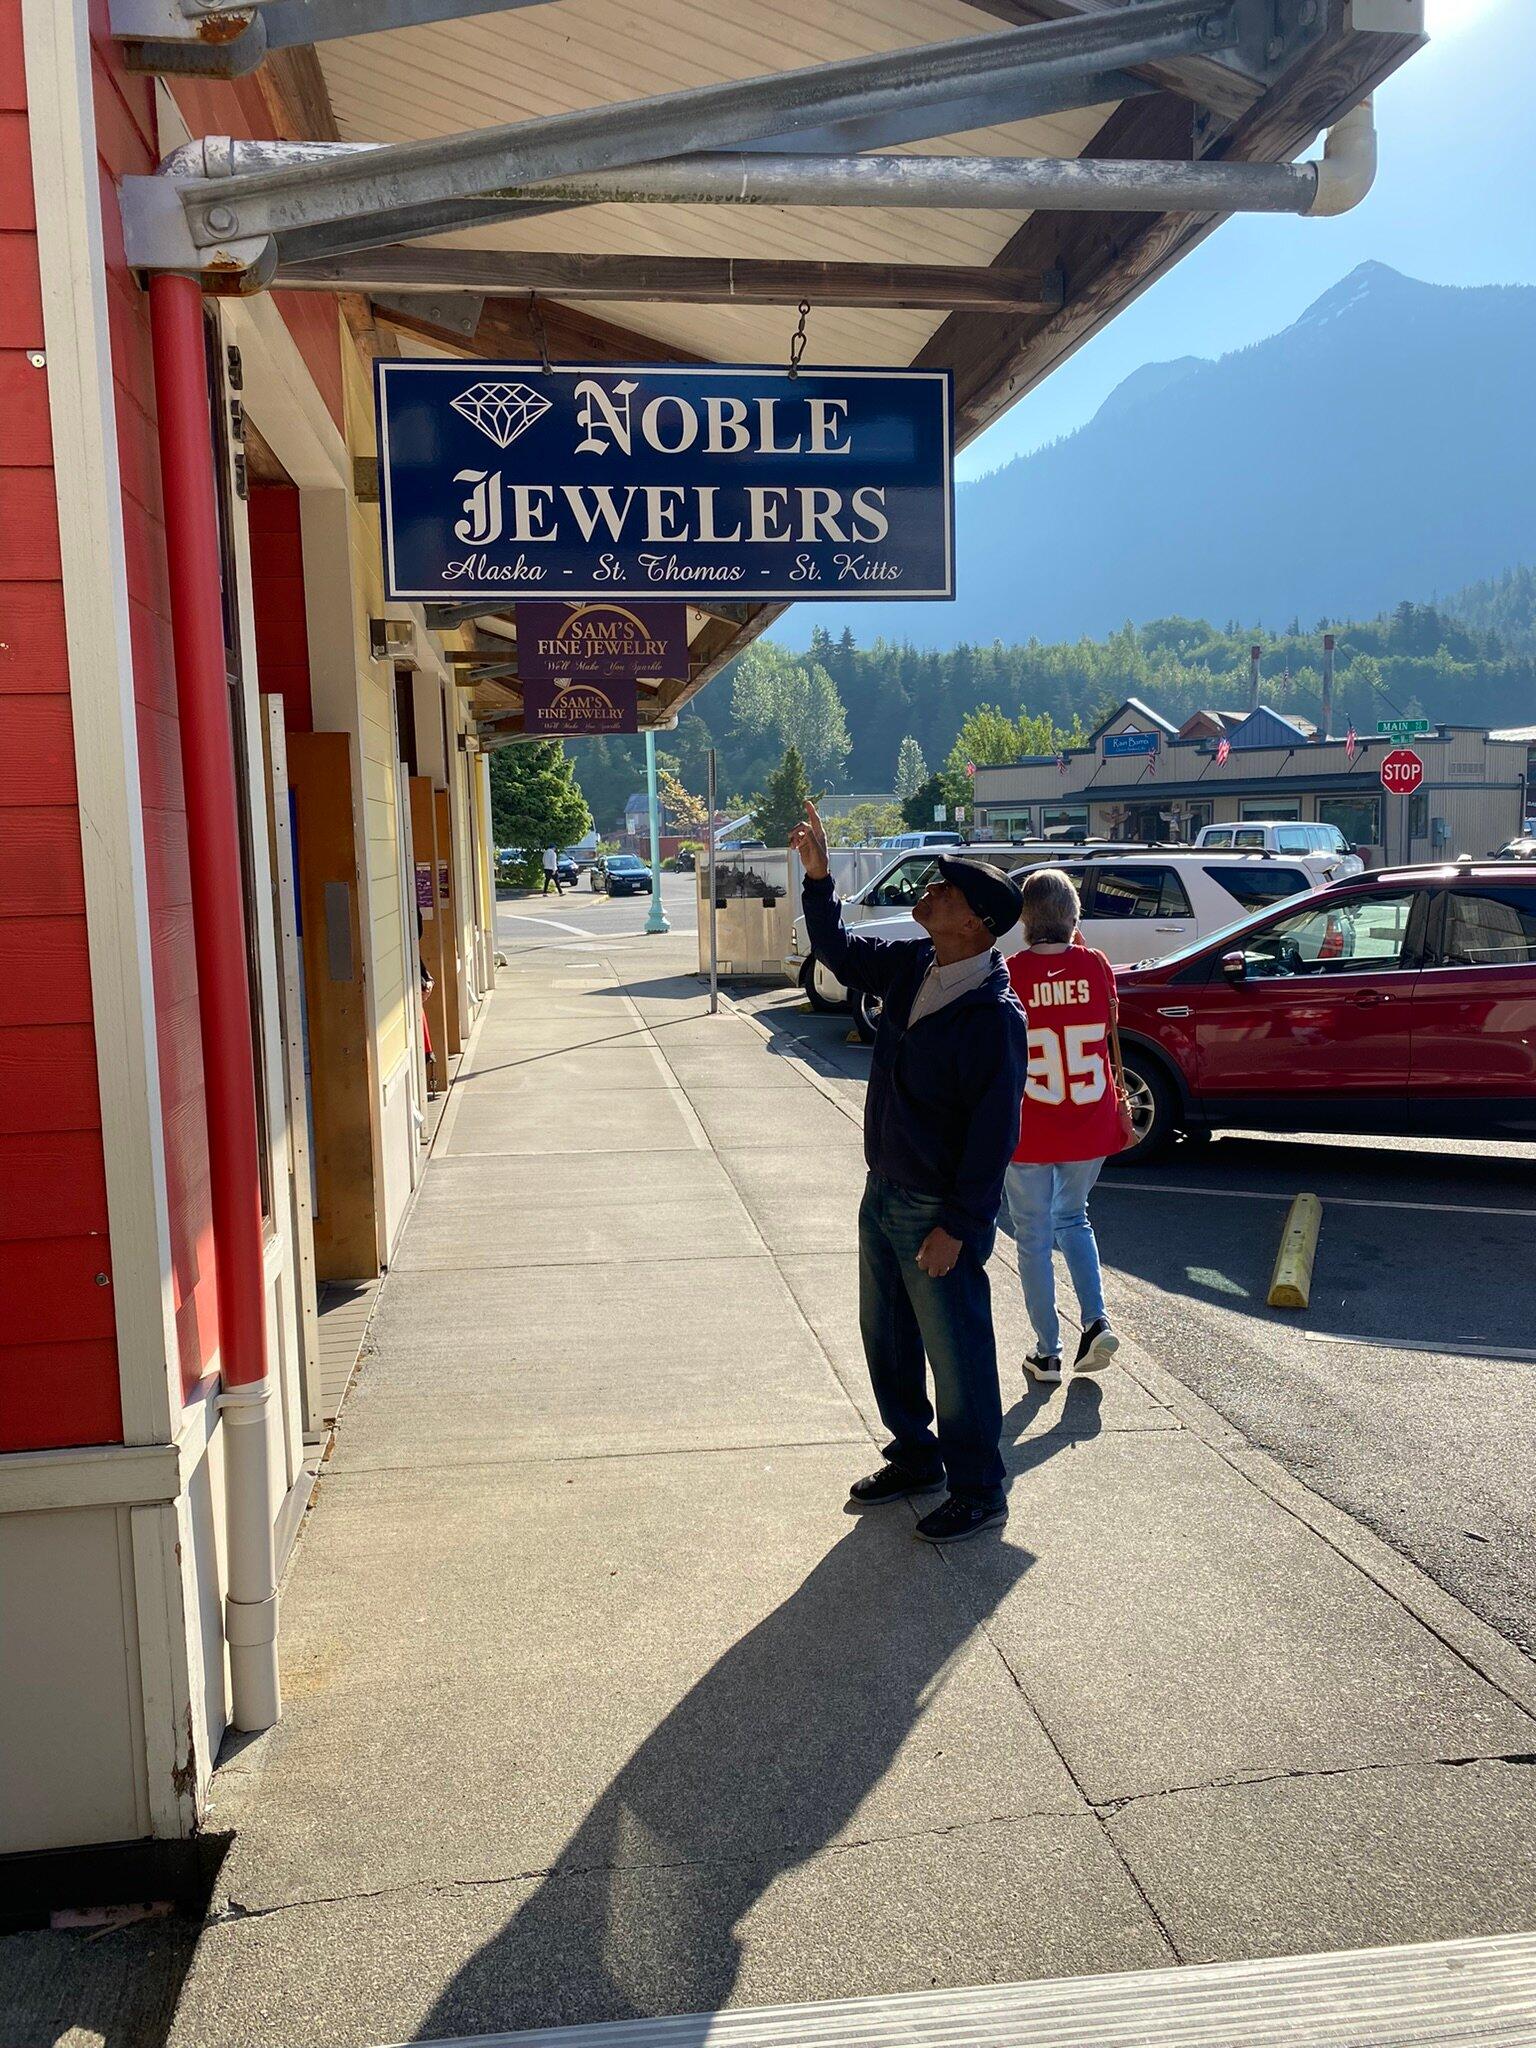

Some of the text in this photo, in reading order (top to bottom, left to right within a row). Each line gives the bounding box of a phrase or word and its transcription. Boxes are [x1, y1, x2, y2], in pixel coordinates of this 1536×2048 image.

[574, 380, 852, 456] NOBLE
[453, 470, 889, 546] JEWELERS
[441, 554, 547, 581] Alaska
[592, 553, 627, 581] St.
[638, 554, 745, 582] Thomas
[788, 554, 822, 581] St.
[832, 554, 902, 581] Kitts
[571, 622, 634, 639] SAM'S
[538, 640, 668, 659] FINE JEWELRY
[576, 661, 599, 671] Make
[603, 661, 624, 676] You
[560, 697, 602, 709] SAM'S
[538, 709, 624, 721] FINE JEWELRY
[1383, 722, 1408, 731] MAIN
[1384, 764, 1421, 780] STOP
[1028, 979, 1090, 1008] JONES
[1025, 1023, 1107, 1106] 95
